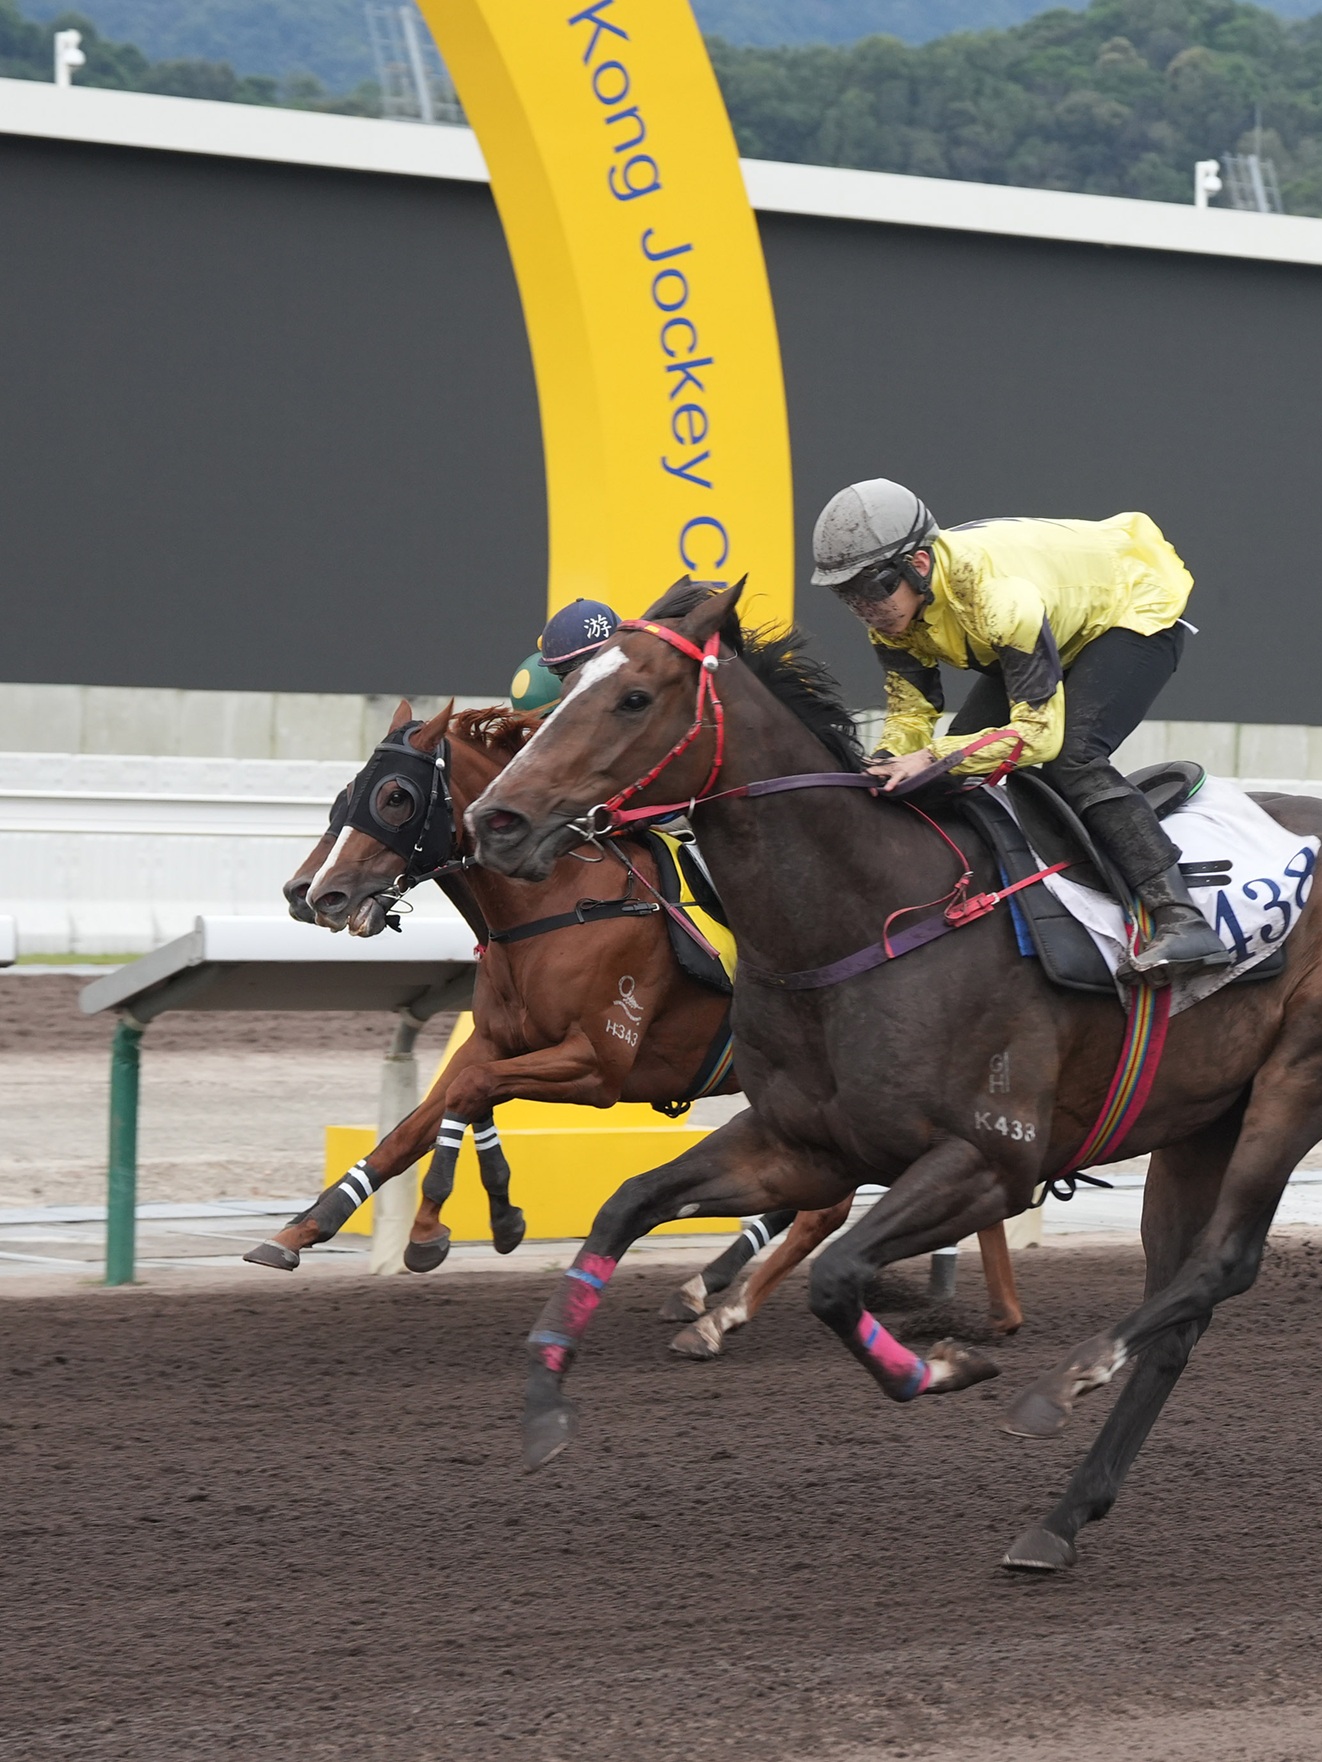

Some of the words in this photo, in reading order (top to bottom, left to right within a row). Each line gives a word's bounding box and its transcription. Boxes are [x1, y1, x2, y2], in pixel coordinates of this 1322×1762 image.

[567, 0, 663, 202] Kong
[641, 227, 714, 490] Jockey
[583, 614, 612, 639] 游
[1215, 846, 1316, 968] 438
